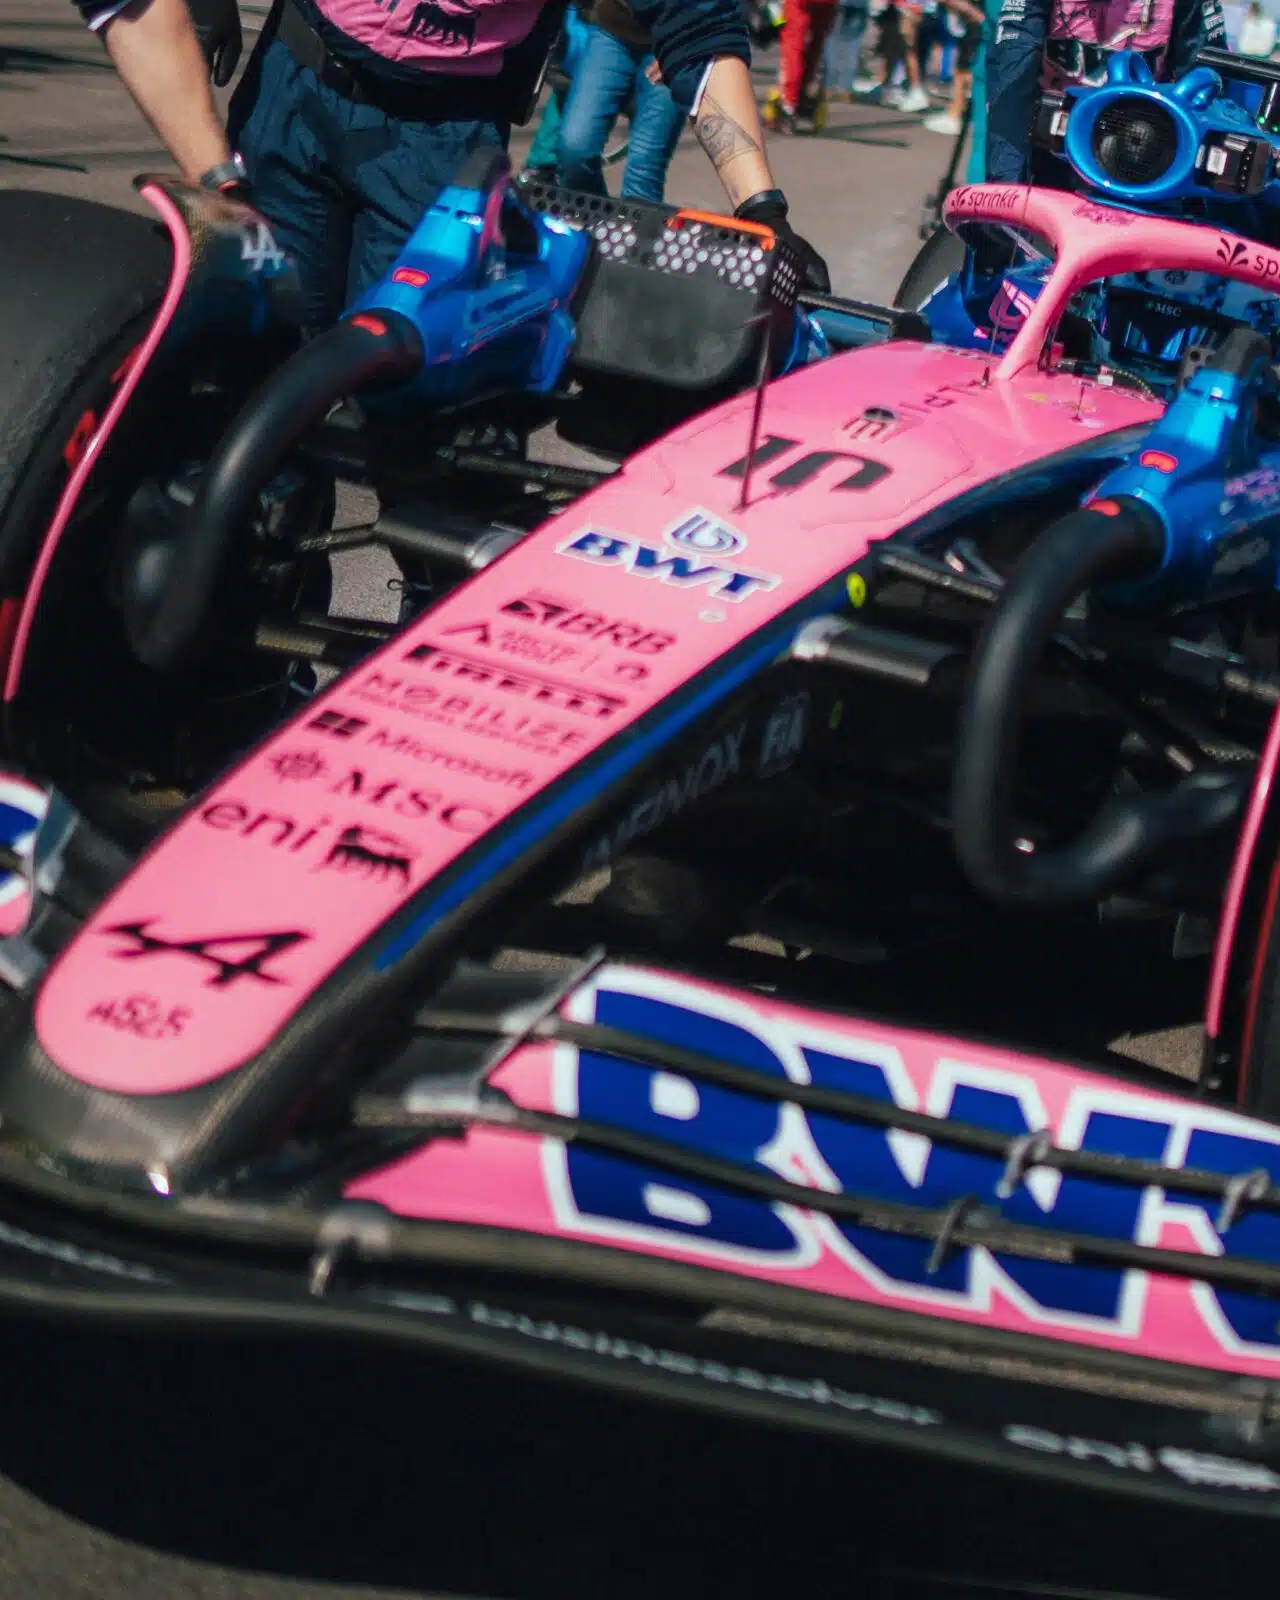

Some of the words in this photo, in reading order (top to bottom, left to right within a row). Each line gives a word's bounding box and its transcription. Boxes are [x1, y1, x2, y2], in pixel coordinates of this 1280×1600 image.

[968, 186, 1020, 214] sprinklr
[556, 526, 783, 603] BWT
[202, 801, 332, 852] eni
[329, 769, 496, 834] MSC
